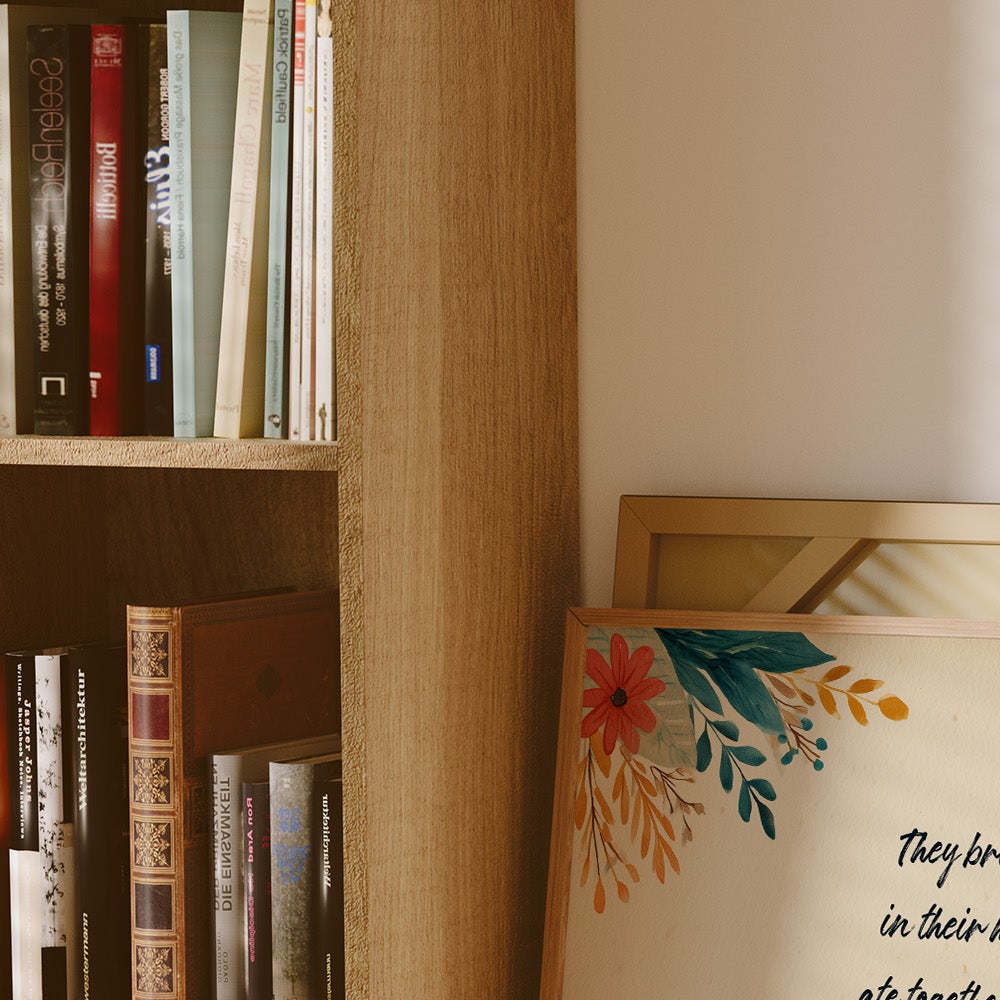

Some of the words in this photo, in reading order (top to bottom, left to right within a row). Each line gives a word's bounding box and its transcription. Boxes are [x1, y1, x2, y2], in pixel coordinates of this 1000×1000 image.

[77, 669, 88, 811] Weltarchitektur
[25, 757, 33, 802] Johns
[898, 829, 962, 888] They
[879, 904, 915, 939] in
[918, 905, 988, 941] their
